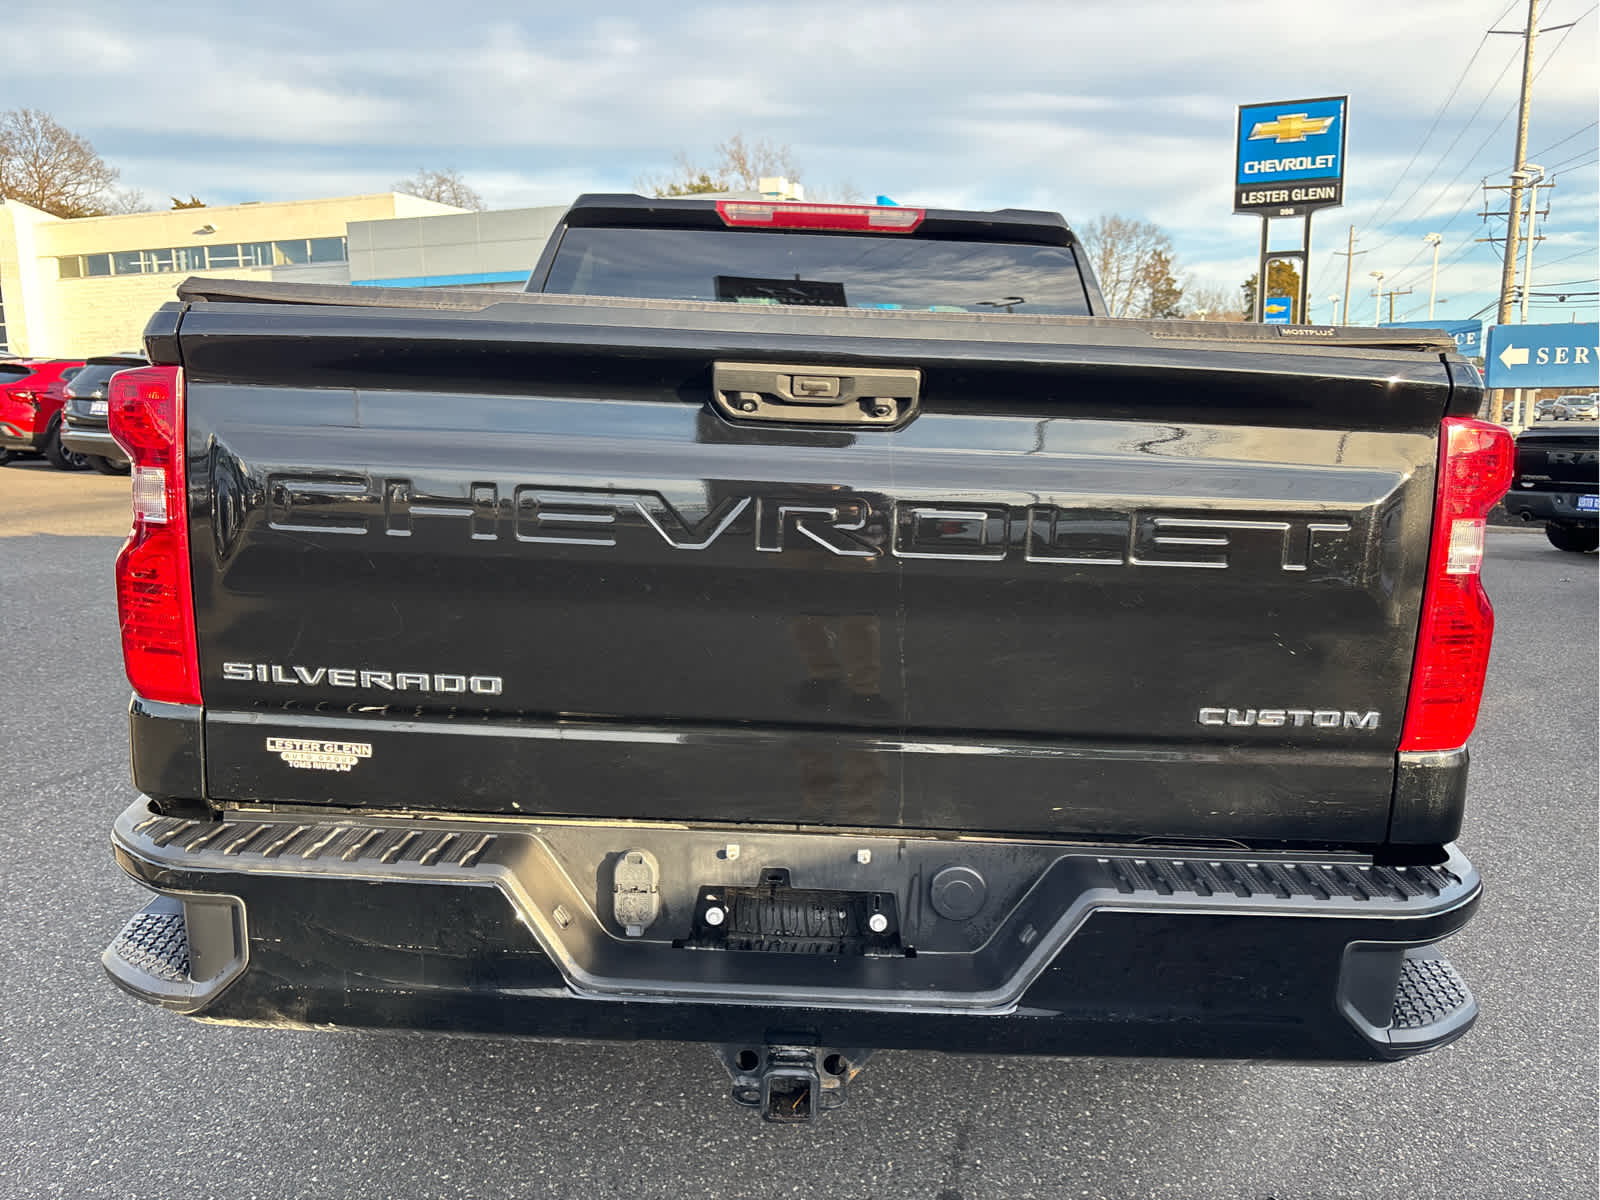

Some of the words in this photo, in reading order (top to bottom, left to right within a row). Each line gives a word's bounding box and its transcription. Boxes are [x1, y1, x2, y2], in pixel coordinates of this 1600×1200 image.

[1244, 154, 1336, 174] CHEVROLET
[1241, 190, 1289, 204] LESTER
[1291, 187, 1335, 201] GLENN
[1454, 332, 1476, 345] CE
[267, 472, 1353, 572] CHEVROLET
[223, 662, 503, 696] SILVERADO
[1199, 707, 1381, 730] CUSTOM
[267, 739, 320, 752] LESTER
[323, 743, 371, 755] GLENN
[317, 754, 355, 764] GROUP
